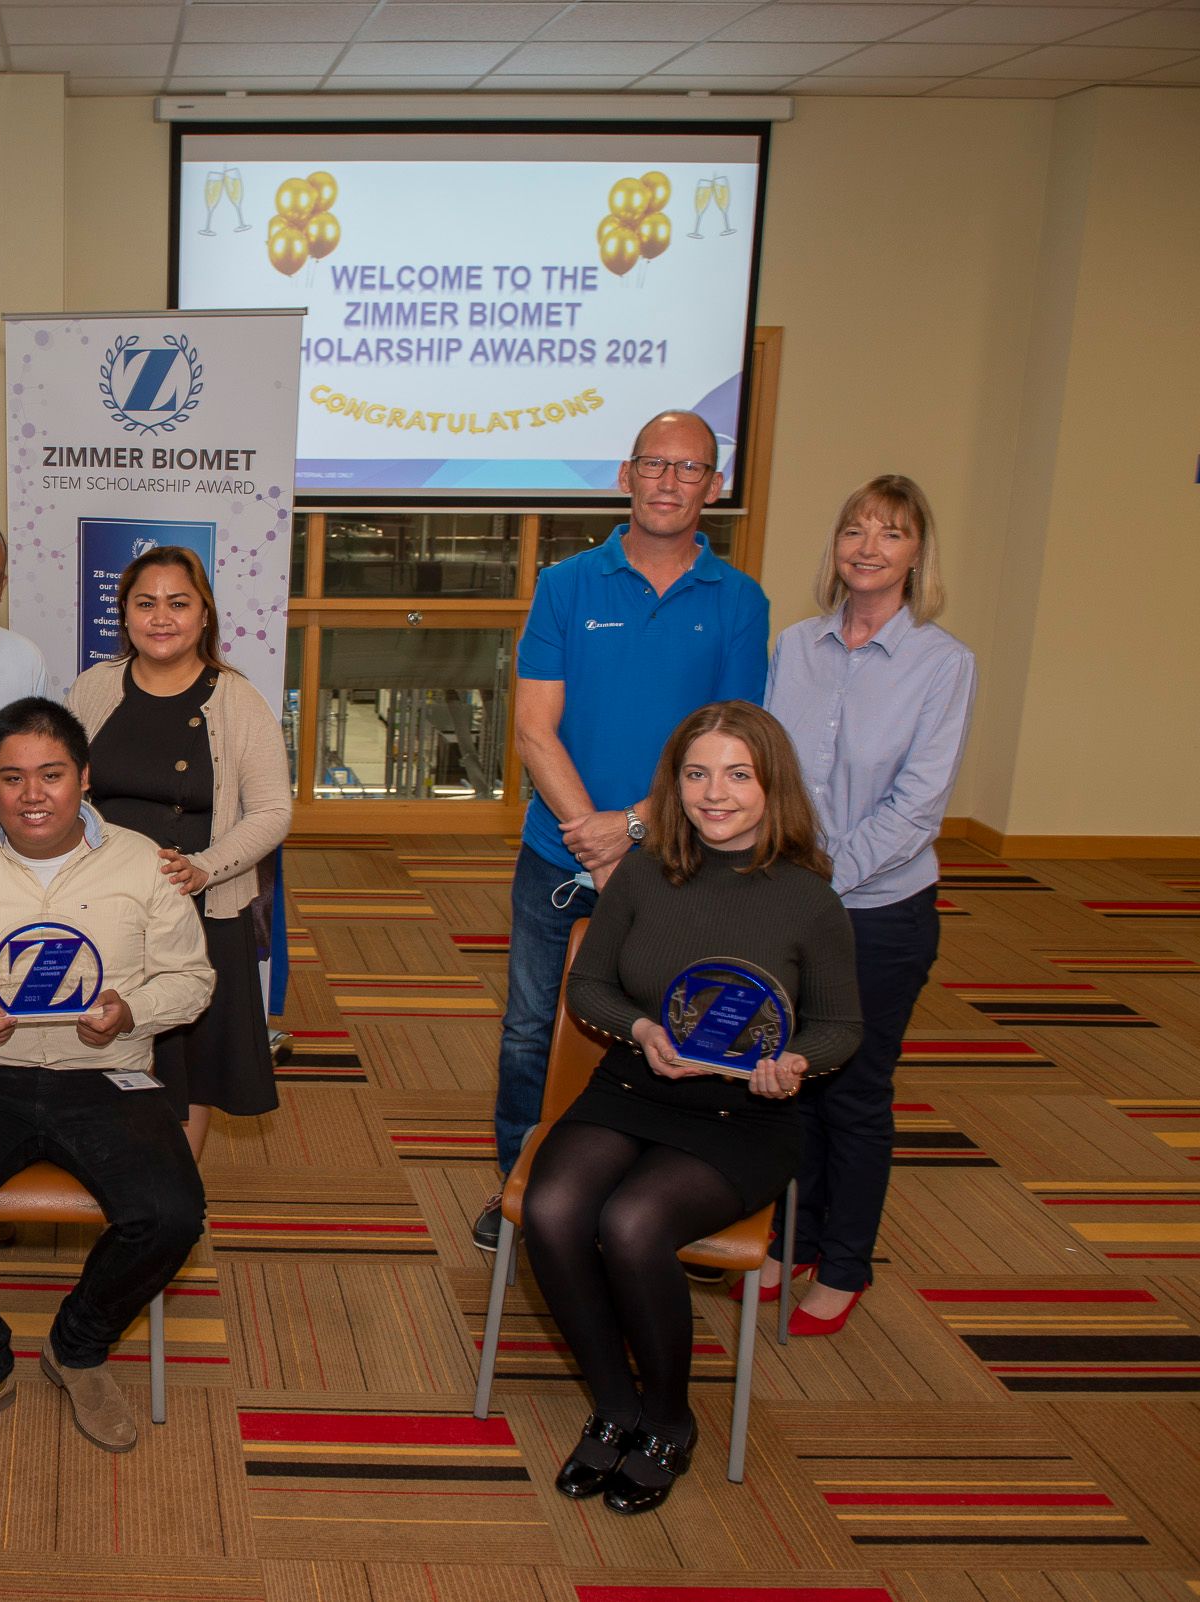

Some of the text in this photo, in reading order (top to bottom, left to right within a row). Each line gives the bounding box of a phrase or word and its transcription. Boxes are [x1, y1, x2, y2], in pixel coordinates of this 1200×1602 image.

[331, 265, 598, 291] WELCOME TO THE
[344, 302, 582, 327] ZIMMER BIOMET
[469, 338, 597, 363] AWARDS
[605, 339, 668, 364] 2021
[310, 385, 604, 434] CONGRATULATIONS
[42, 446, 257, 471] ZIMMER BIOMET
[42, 475, 255, 495] STEM SCHOLARSHIP AWARD
[99, 629, 118, 637] their
